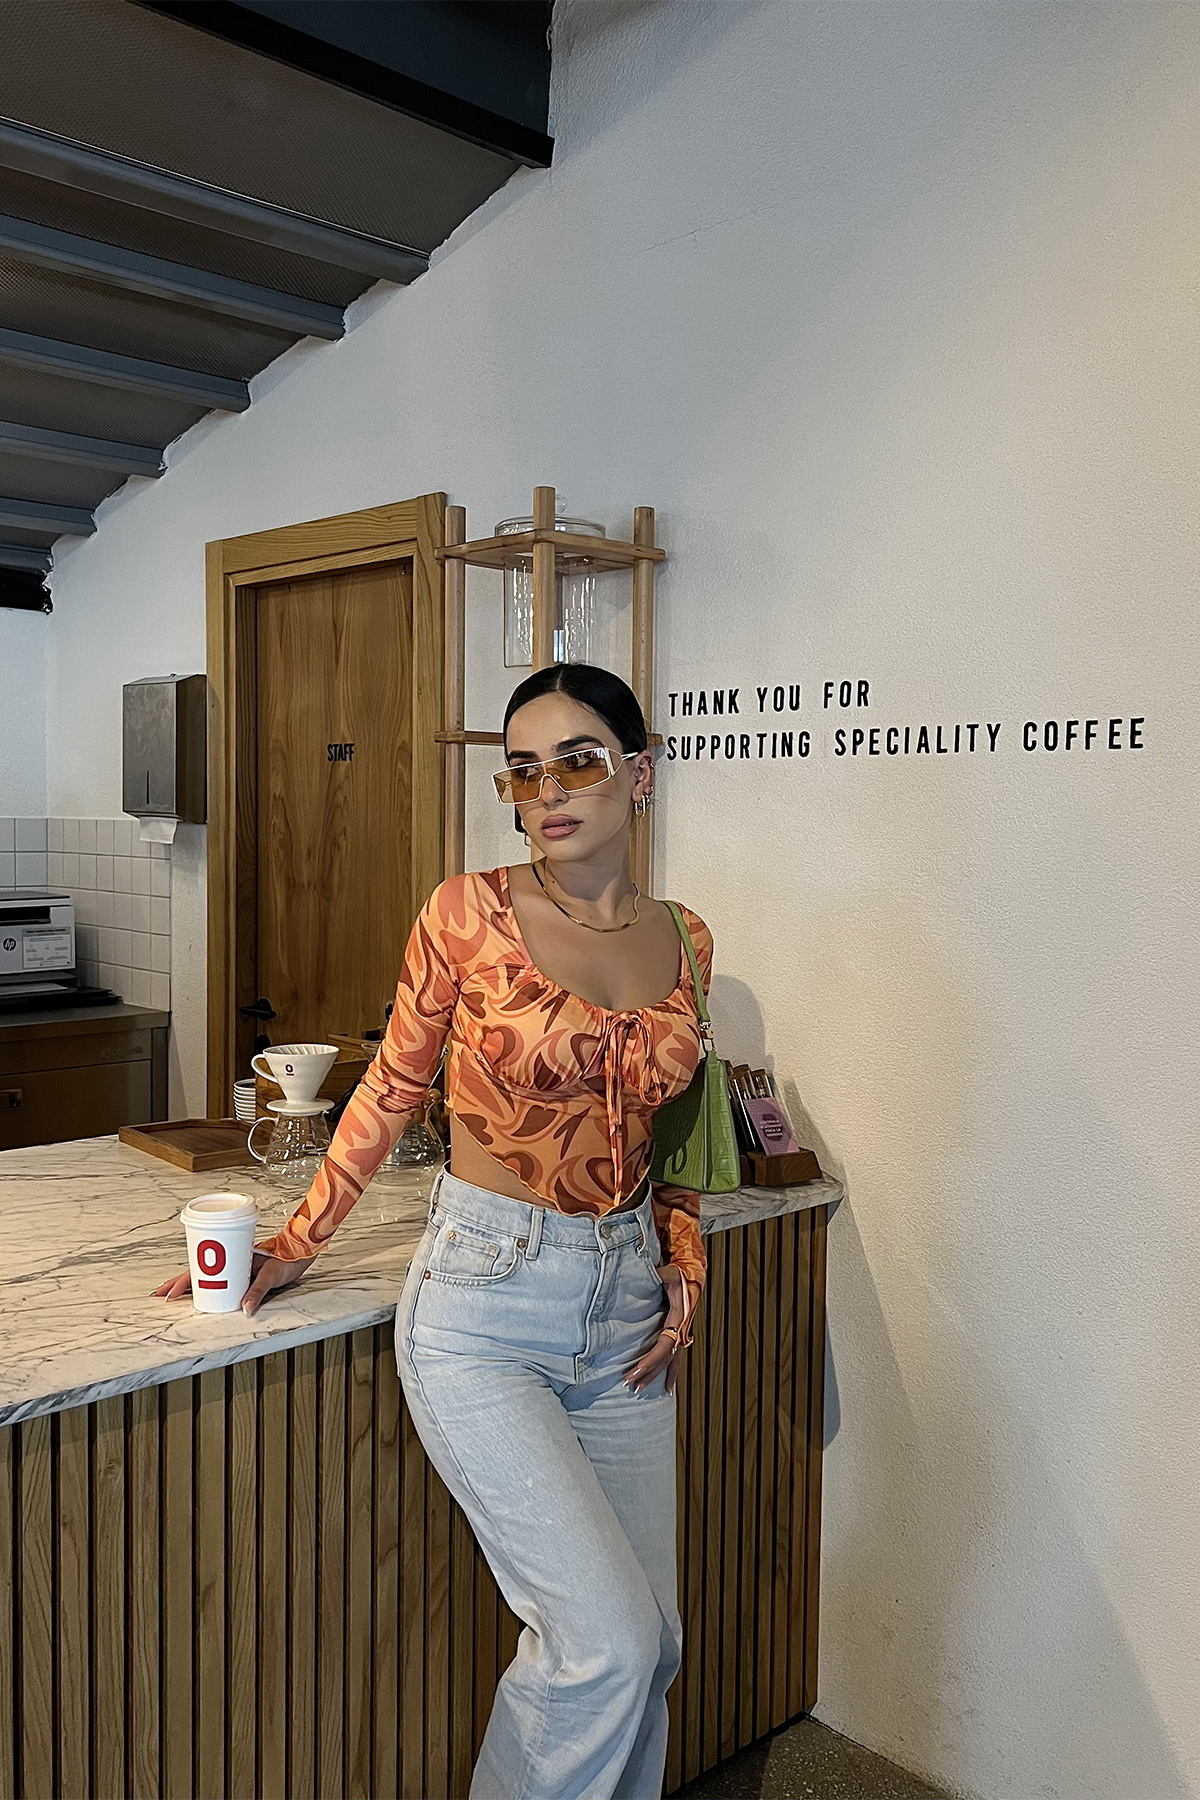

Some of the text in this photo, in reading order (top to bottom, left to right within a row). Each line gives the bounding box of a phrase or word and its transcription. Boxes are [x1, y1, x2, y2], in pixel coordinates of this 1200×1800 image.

[668, 679, 870, 718] THANK YOU FOR
[327, 743, 355, 762] STAFF
[666, 717, 1145, 761] SUPPORTING SPECIALITY COFFEE
[4, 939, 15, 951] hp
